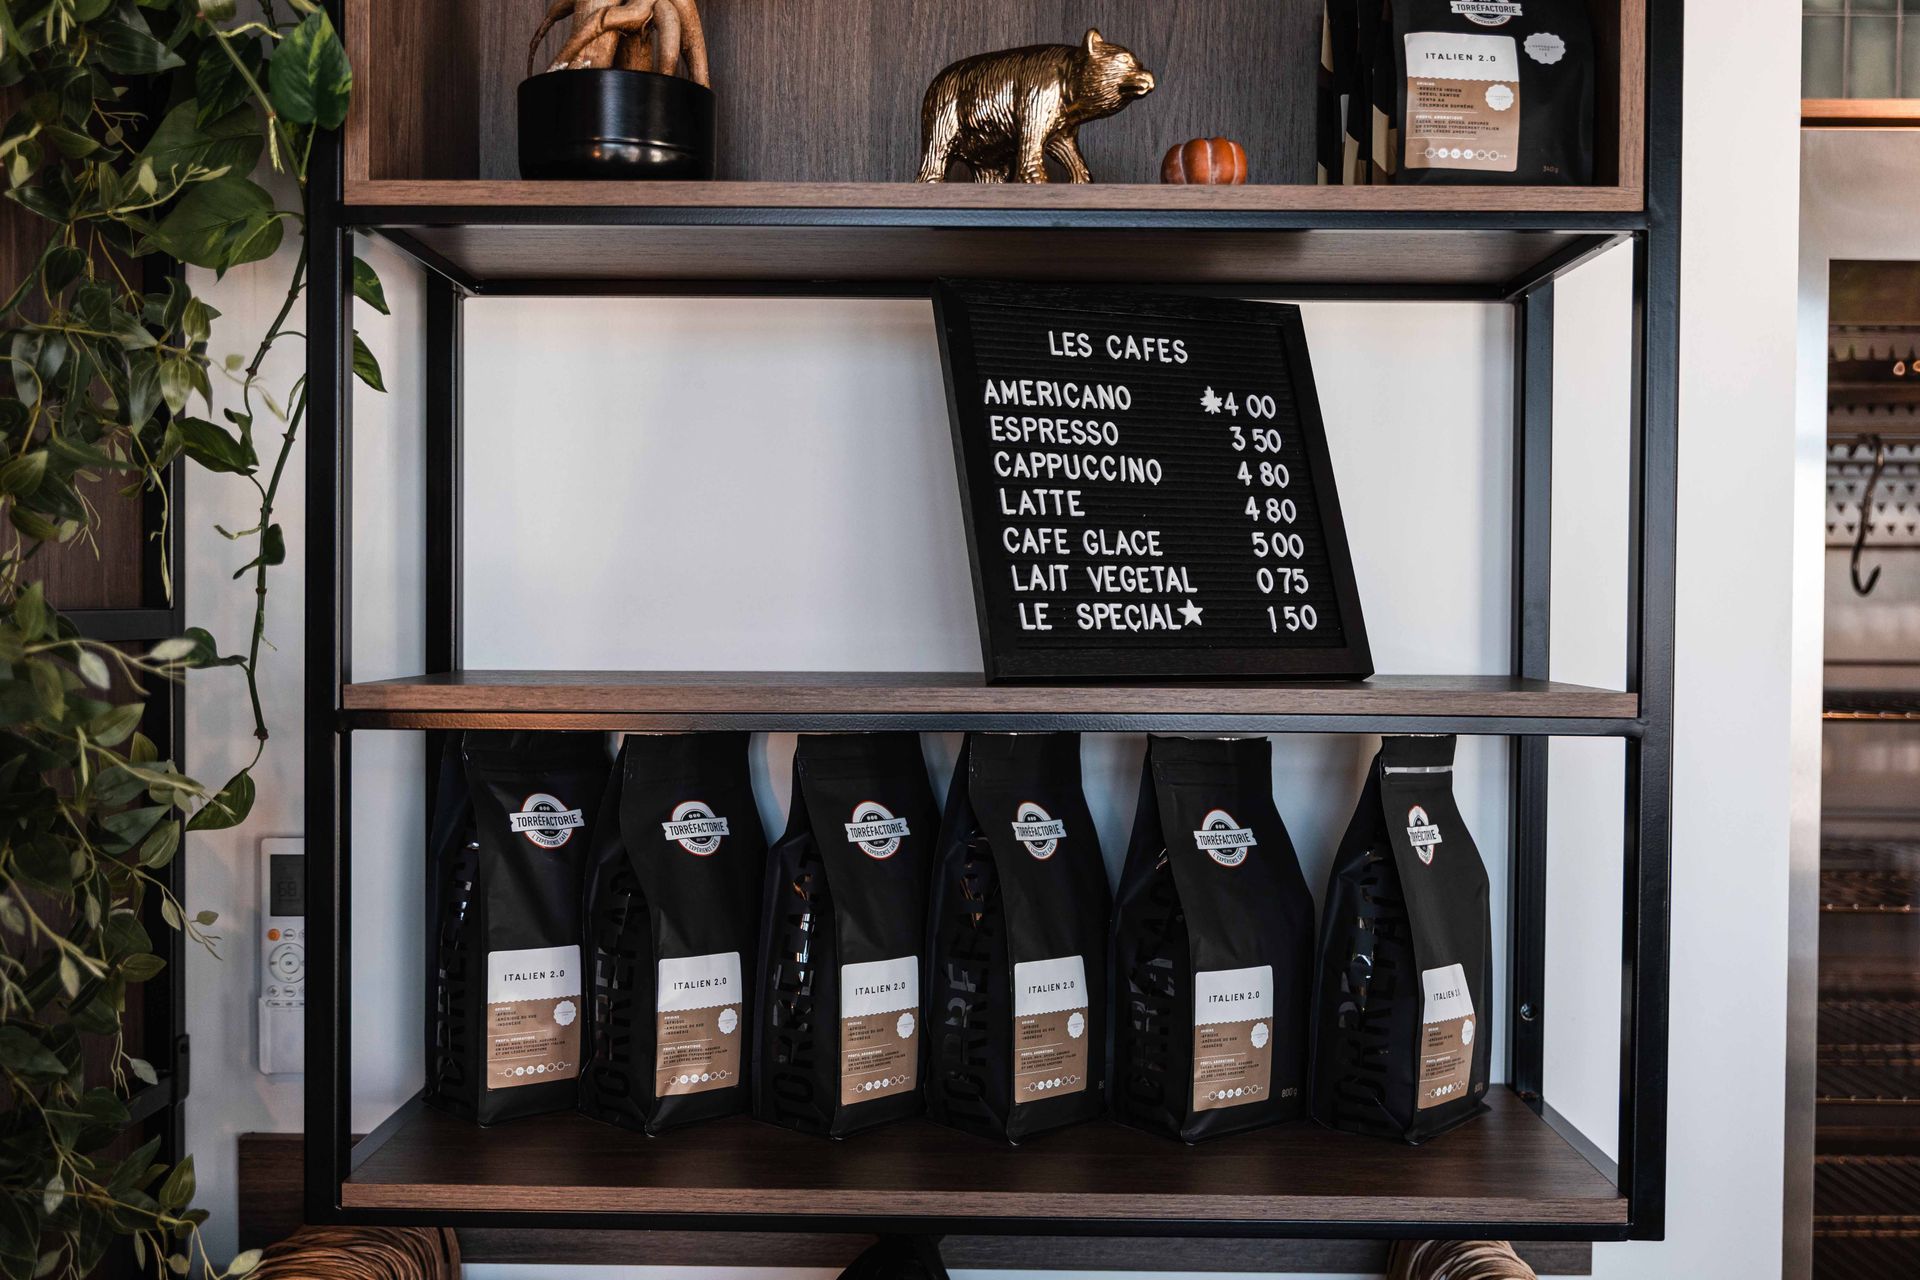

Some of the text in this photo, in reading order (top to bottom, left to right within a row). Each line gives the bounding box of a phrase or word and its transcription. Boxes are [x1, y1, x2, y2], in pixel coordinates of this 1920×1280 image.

[1456, 4, 1517, 14] TORRÉFACTORIE
[1425, 52, 1496, 62] ITALIEN 2.0
[1049, 331, 1188, 363] LES CAFES
[985, 379, 1131, 410] AMERICANO
[990, 416, 1118, 445] ESPRESSO
[995, 452, 1161, 485] CAPPUCCINO
[1000, 488, 1085, 516] LATTE
[1003, 527, 1070, 554] CAFE
[1083, 529, 1163, 556] GLACE
[1011, 564, 1068, 591] LAIT
[1087, 566, 1197, 593] VEGETAL
[1019, 603, 1052, 630] LE
[1077, 603, 1182, 632] SPECIAL
[516, 814, 578, 828] TORRÉFACTORIE
[669, 822, 724, 836] TORRÉFACTORIE
[850, 823, 904, 838] TORRÉFACTORIE
[1199, 833, 1251, 846] TORRÉFACTORIE
[504, 968, 565, 982] ITALIEN 2.0
[674, 976, 727, 991] ITALIEN 2.0
[855, 981, 906, 996] ITALIEN 2.0
[1028, 981, 1075, 995] ITALIEN 2.0
[1208, 991, 1260, 1004] ITALIEN 2.0
[1434, 990, 1454, 1000] ITALIEN
